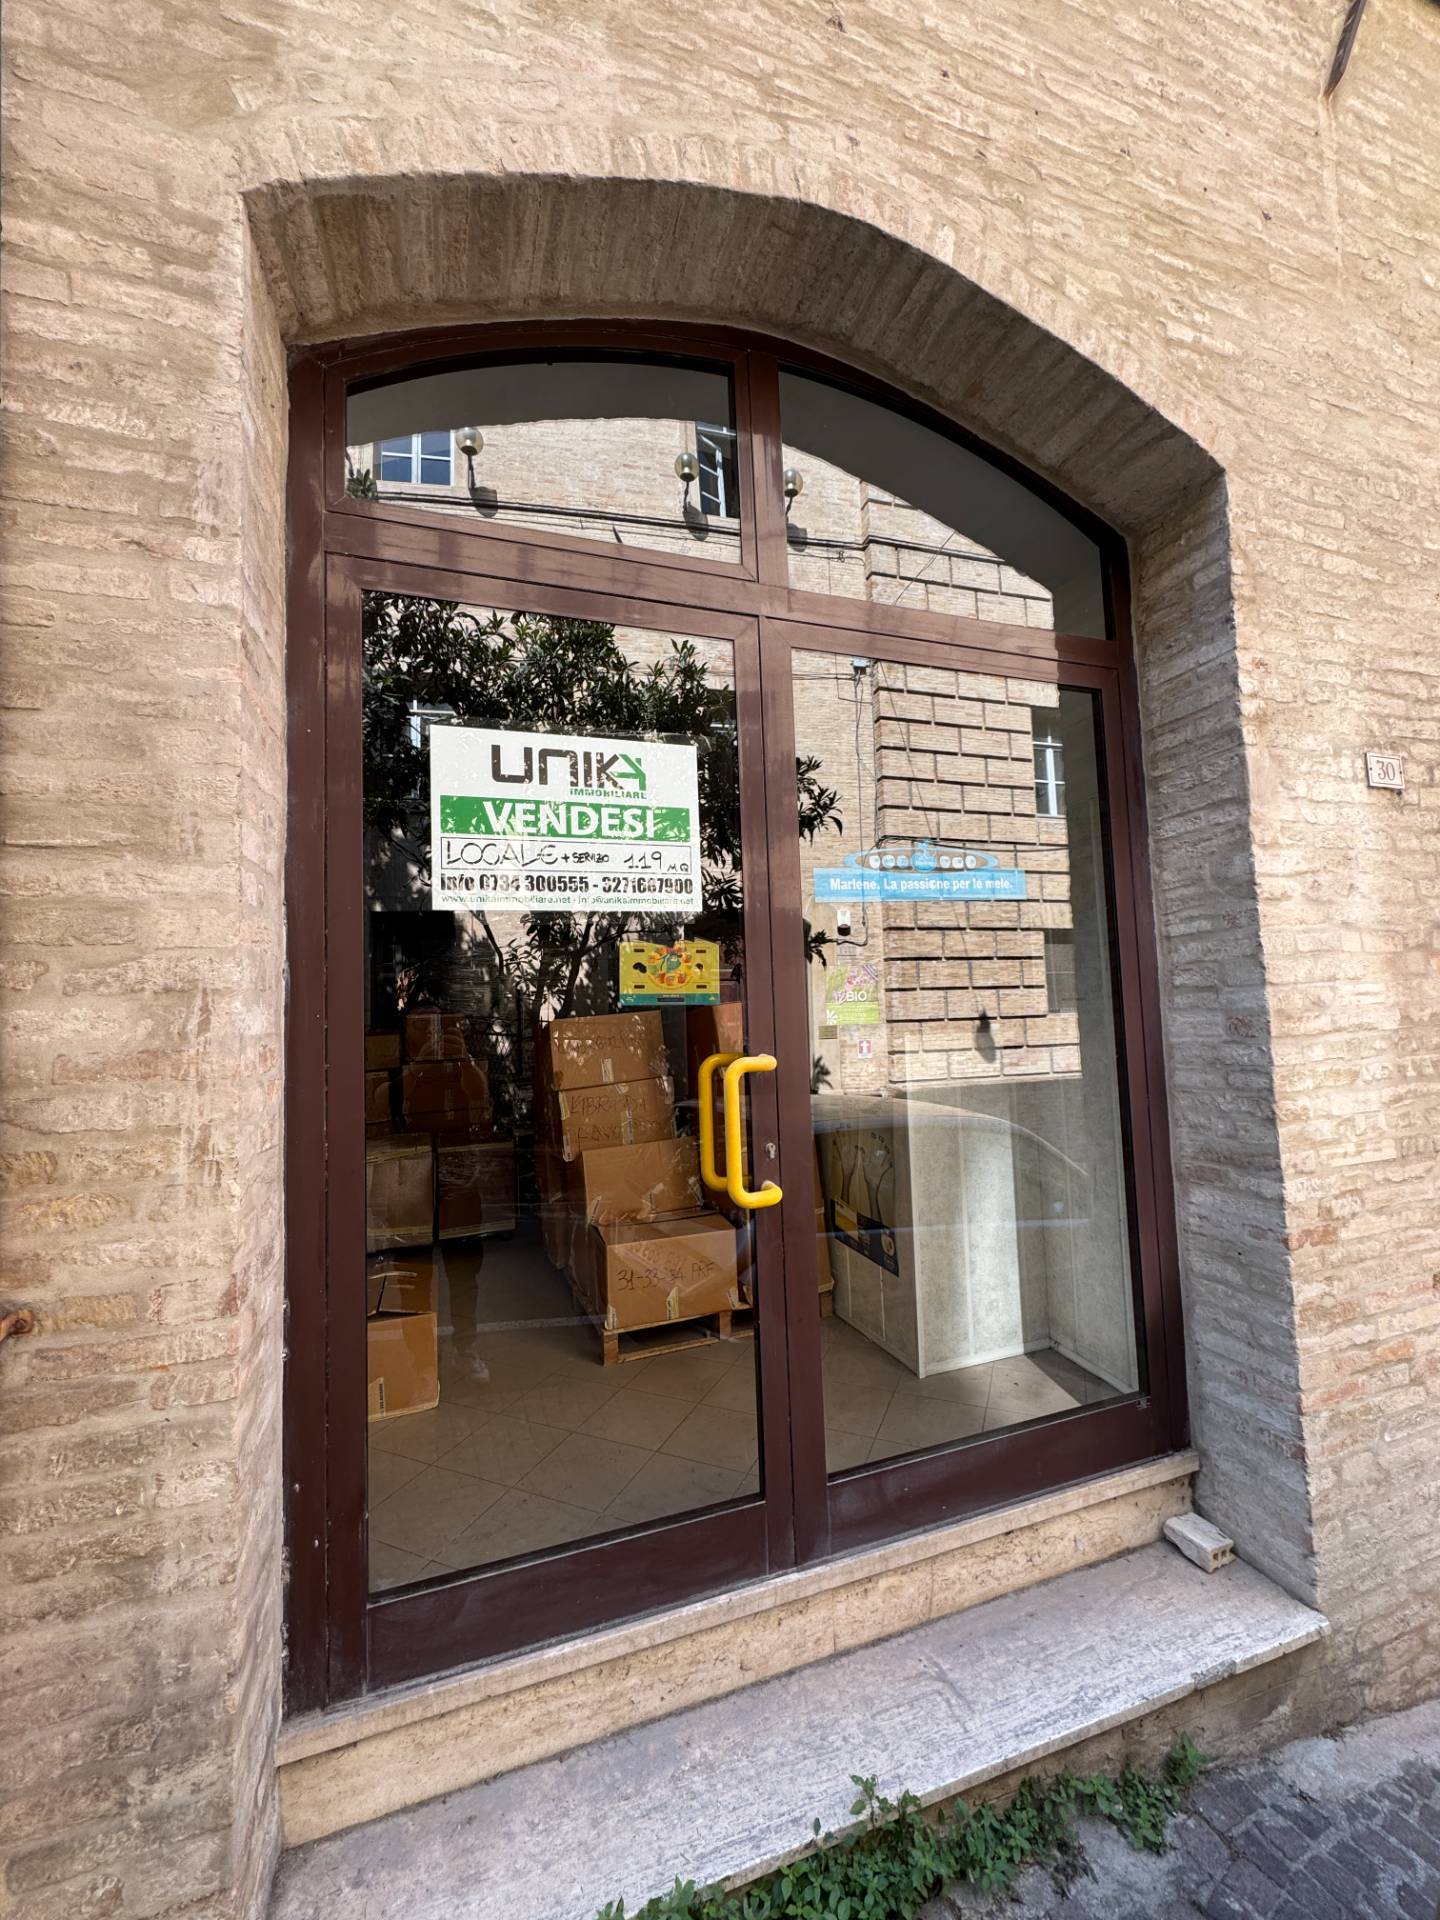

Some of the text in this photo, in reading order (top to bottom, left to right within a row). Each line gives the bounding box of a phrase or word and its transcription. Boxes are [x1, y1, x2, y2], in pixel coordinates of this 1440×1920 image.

[1376, 760, 1395, 781] 30
[482, 800, 655, 838] VENDESI
[447, 840, 558, 867] LOCALE
[479, 873, 521, 892] 0734
[524, 875, 589, 893] 300555
[830, 878, 880, 891] Marlene.
[883, 878, 897, 890] La
[900, 878, 951, 893] passione
[953, 880, 970, 892] per
[972, 878, 982, 889] le
